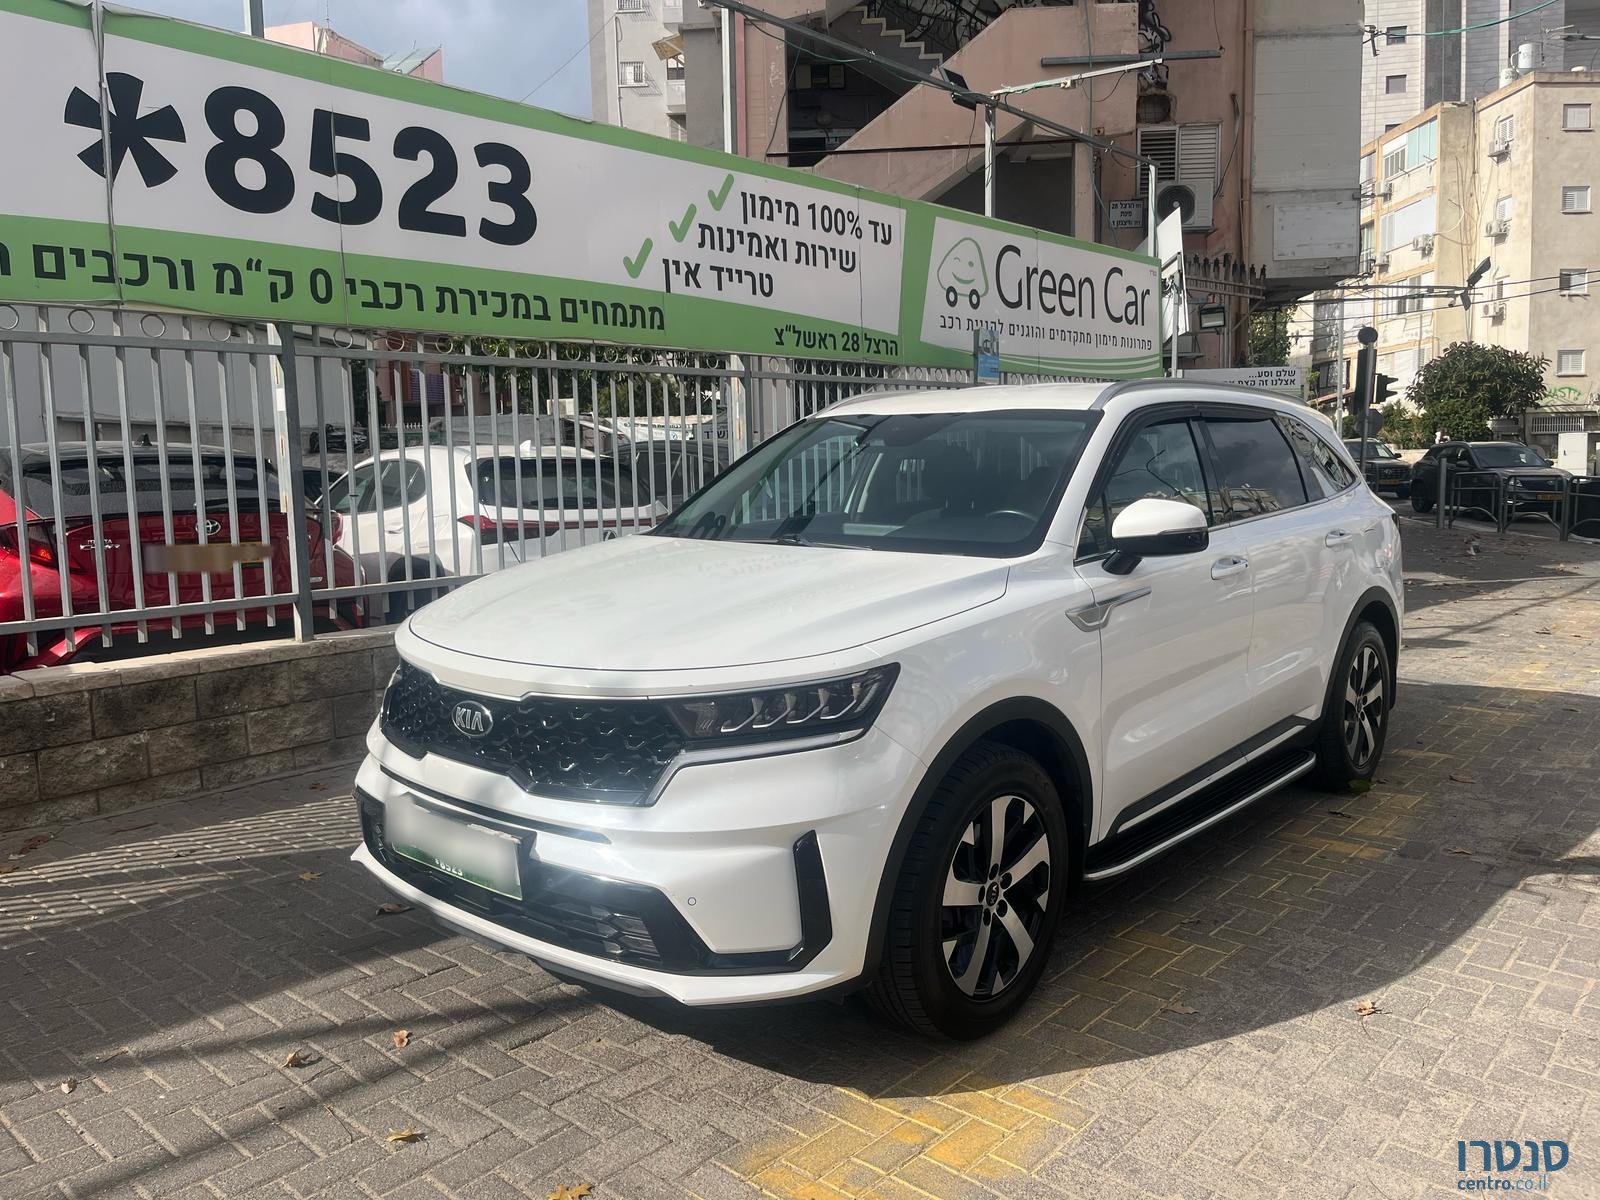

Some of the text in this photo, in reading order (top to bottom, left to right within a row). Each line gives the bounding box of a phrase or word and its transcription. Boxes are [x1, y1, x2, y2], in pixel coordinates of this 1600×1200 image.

[740, 191, 892, 246] עד 100% מימון
[698, 223, 857, 273] שירות ואמינות
[32, 243, 195, 291] ורכבים
[662, 258, 774, 297] טרייד אין
[309, 268, 333, 304] 0
[345, 277, 424, 311] רכבי
[995, 244, 1150, 327] Green Car
[435, 286, 552, 321] במכירת
[560, 297, 665, 331] מתמחים
[939, 315, 962, 331] רכב
[1009, 323, 1045, 340] והוגנים
[1050, 328, 1092, 348] מתקדמים
[841, 333, 860, 353] 28
[864, 333, 898, 356] הרצל
[1095, 334, 1118, 348] מימון
[1120, 336, 1152, 351] פתרונות
[1276, 369, 1296, 377] שלם
[455, 706, 484, 732] KIA
